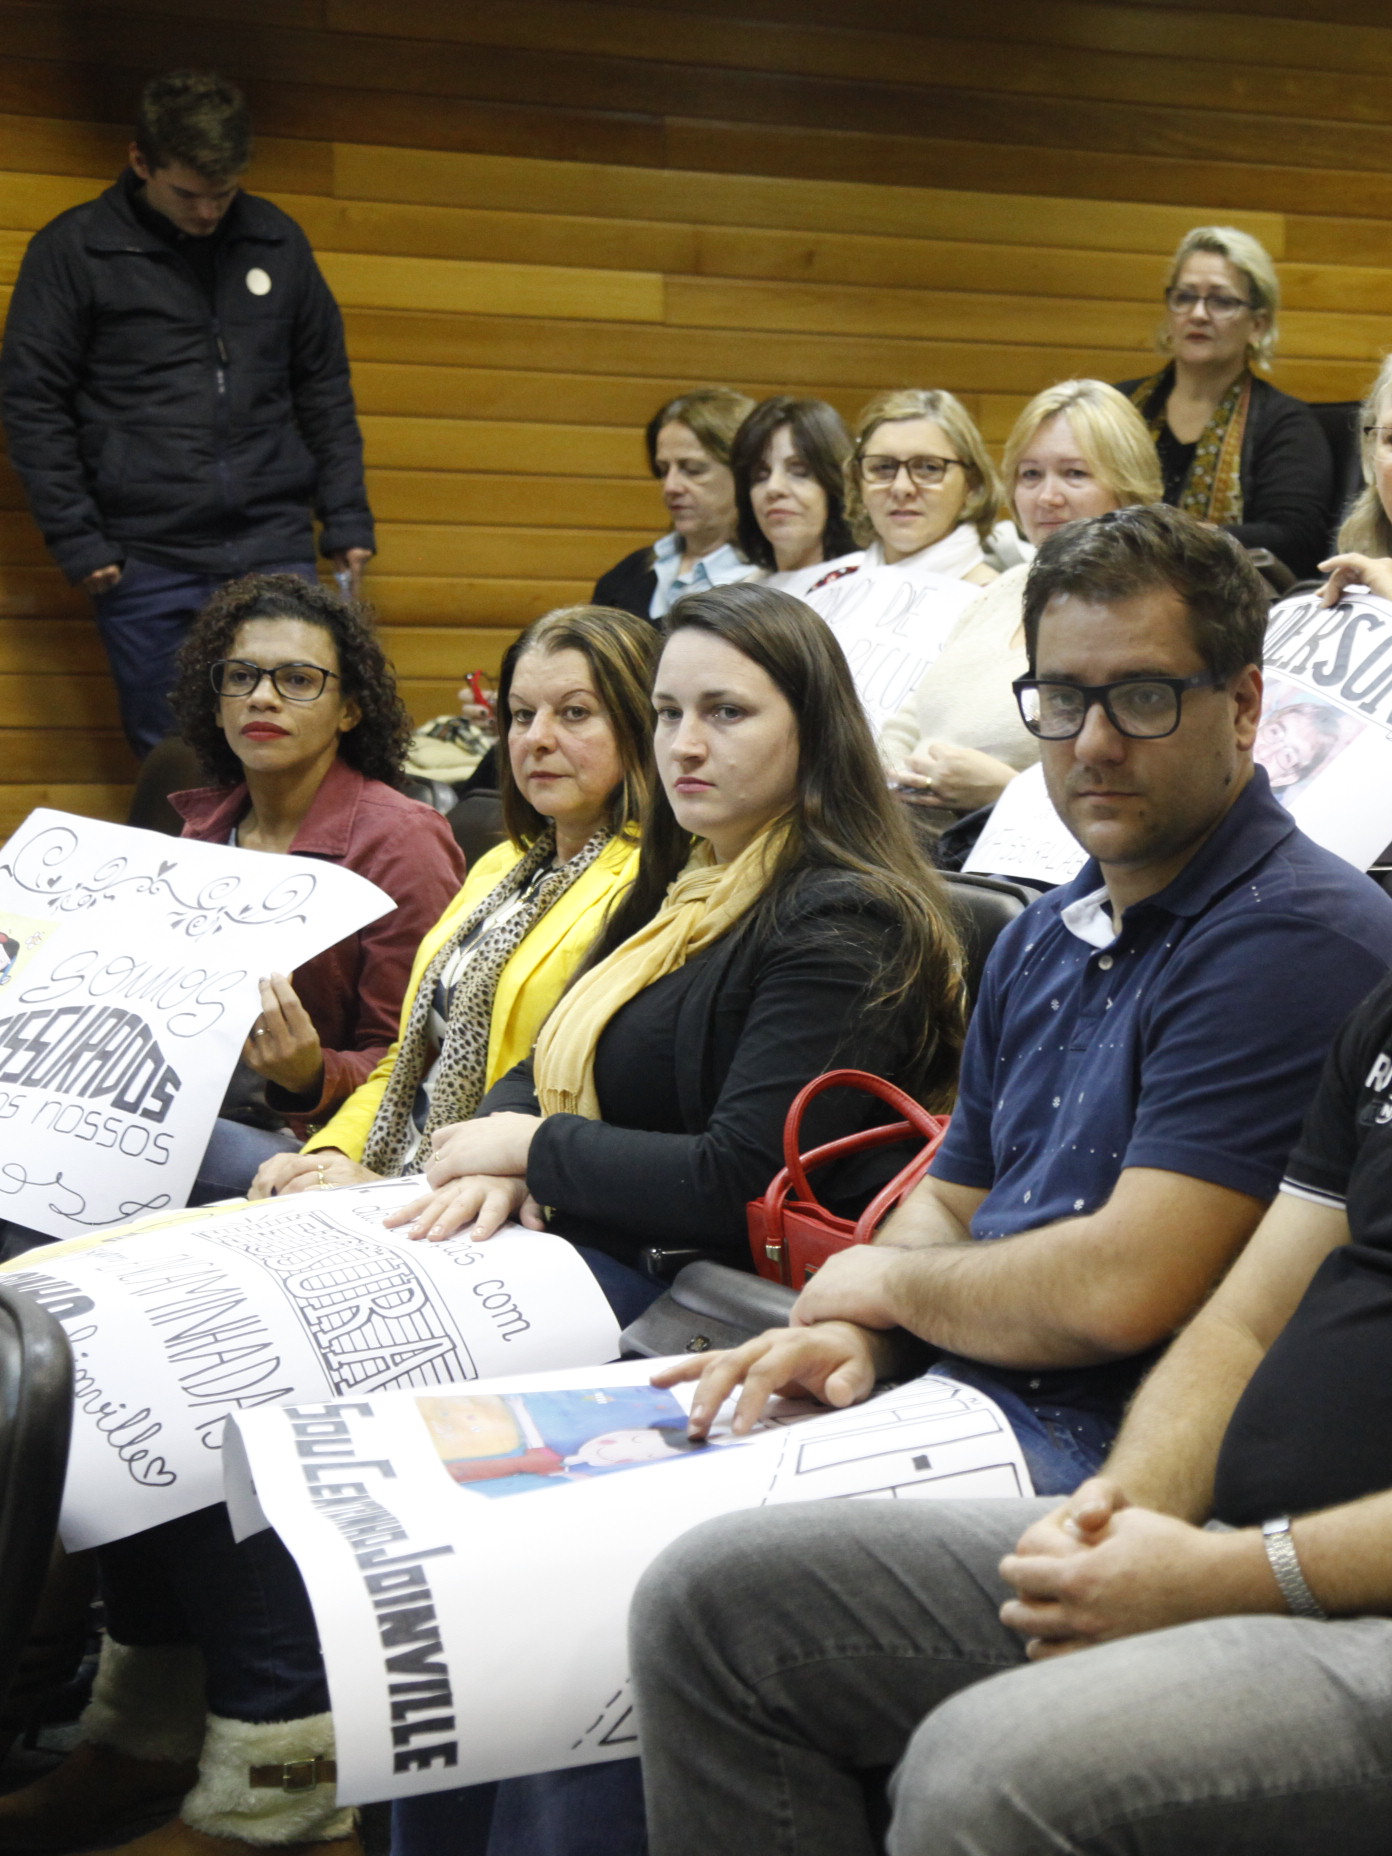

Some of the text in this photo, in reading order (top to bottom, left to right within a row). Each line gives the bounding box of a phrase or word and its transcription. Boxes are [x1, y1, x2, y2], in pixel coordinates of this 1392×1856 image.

[875, 581, 937, 638] DE
[0, 1005, 183, 1124] SSURADOS
[472, 1278, 531, 1342] com
[361, 1544, 459, 1776] JOINVILLE
